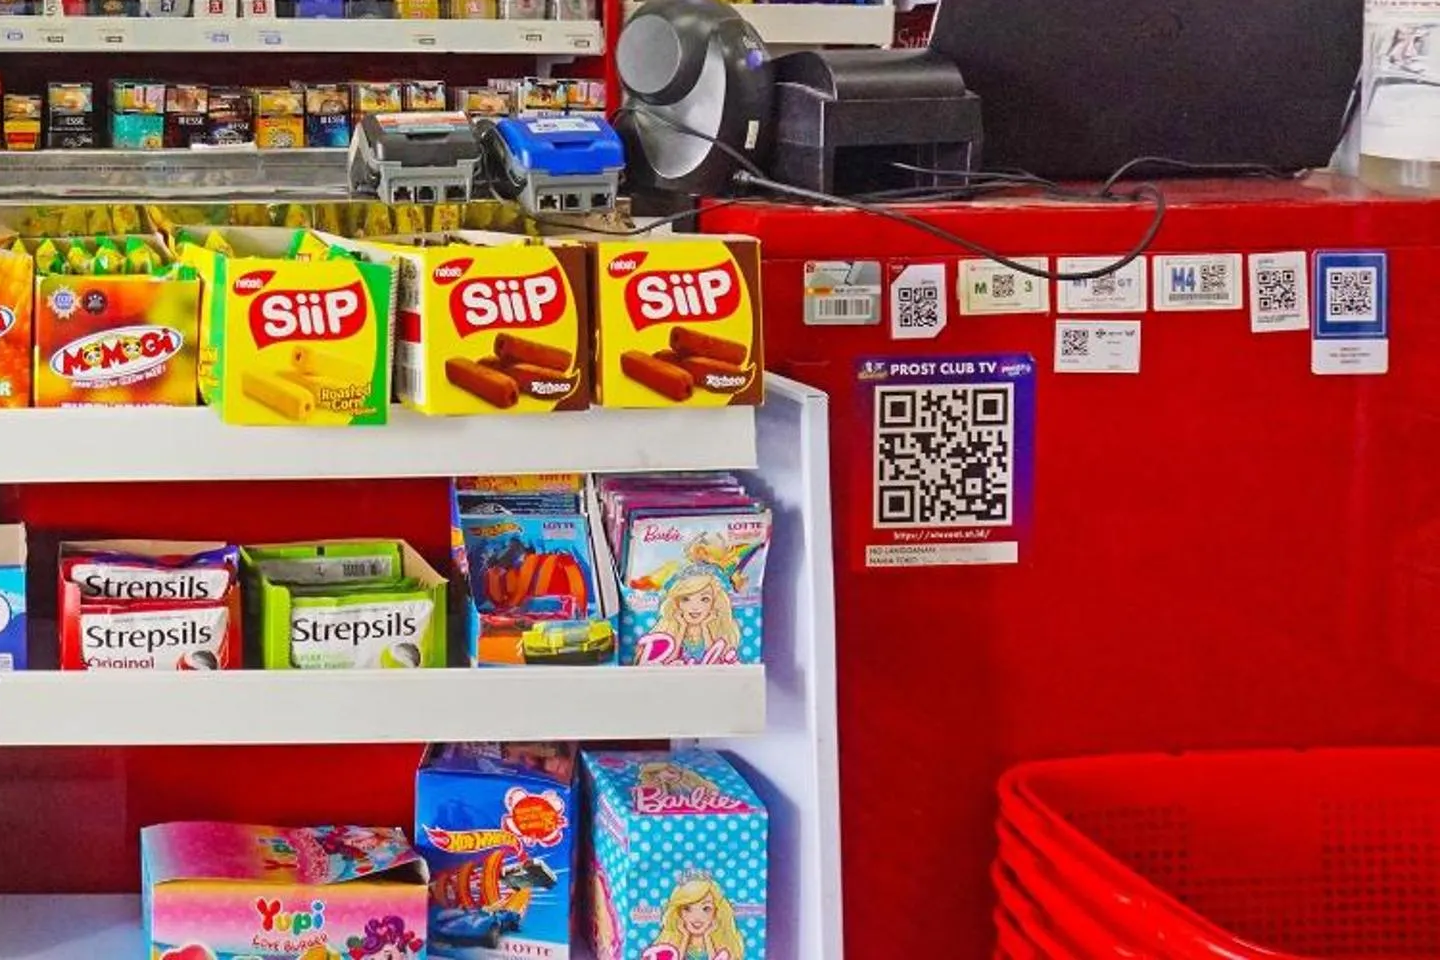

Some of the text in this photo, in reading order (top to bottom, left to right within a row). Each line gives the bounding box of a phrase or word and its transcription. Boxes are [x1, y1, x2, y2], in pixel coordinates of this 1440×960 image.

[66, 116, 85, 125] ESSE
[185, 116, 204, 125] ESSE
[974, 280, 1033, 294] M 3
[1171, 267, 1197, 292] M4
[462, 276, 558, 326] SiiP
[637, 269, 732, 320] SiiP
[262, 290, 358, 338] SiiP
[889, 363, 936, 376] PROST
[939, 362, 975, 375] CLUB
[978, 361, 997, 374] TV
[319, 383, 372, 402] Roasted
[331, 397, 362, 411] Corn
[542, 521, 575, 530] LOTTE
[643, 524, 682, 542] Barbie
[727, 521, 762, 531] LOTTE
[83, 574, 209, 599] Strepsils
[86, 621, 212, 653] Strepsils
[292, 612, 417, 645] Strepsils
[631, 785, 742, 813] Barbie
[256, 897, 326, 935] Yupi
